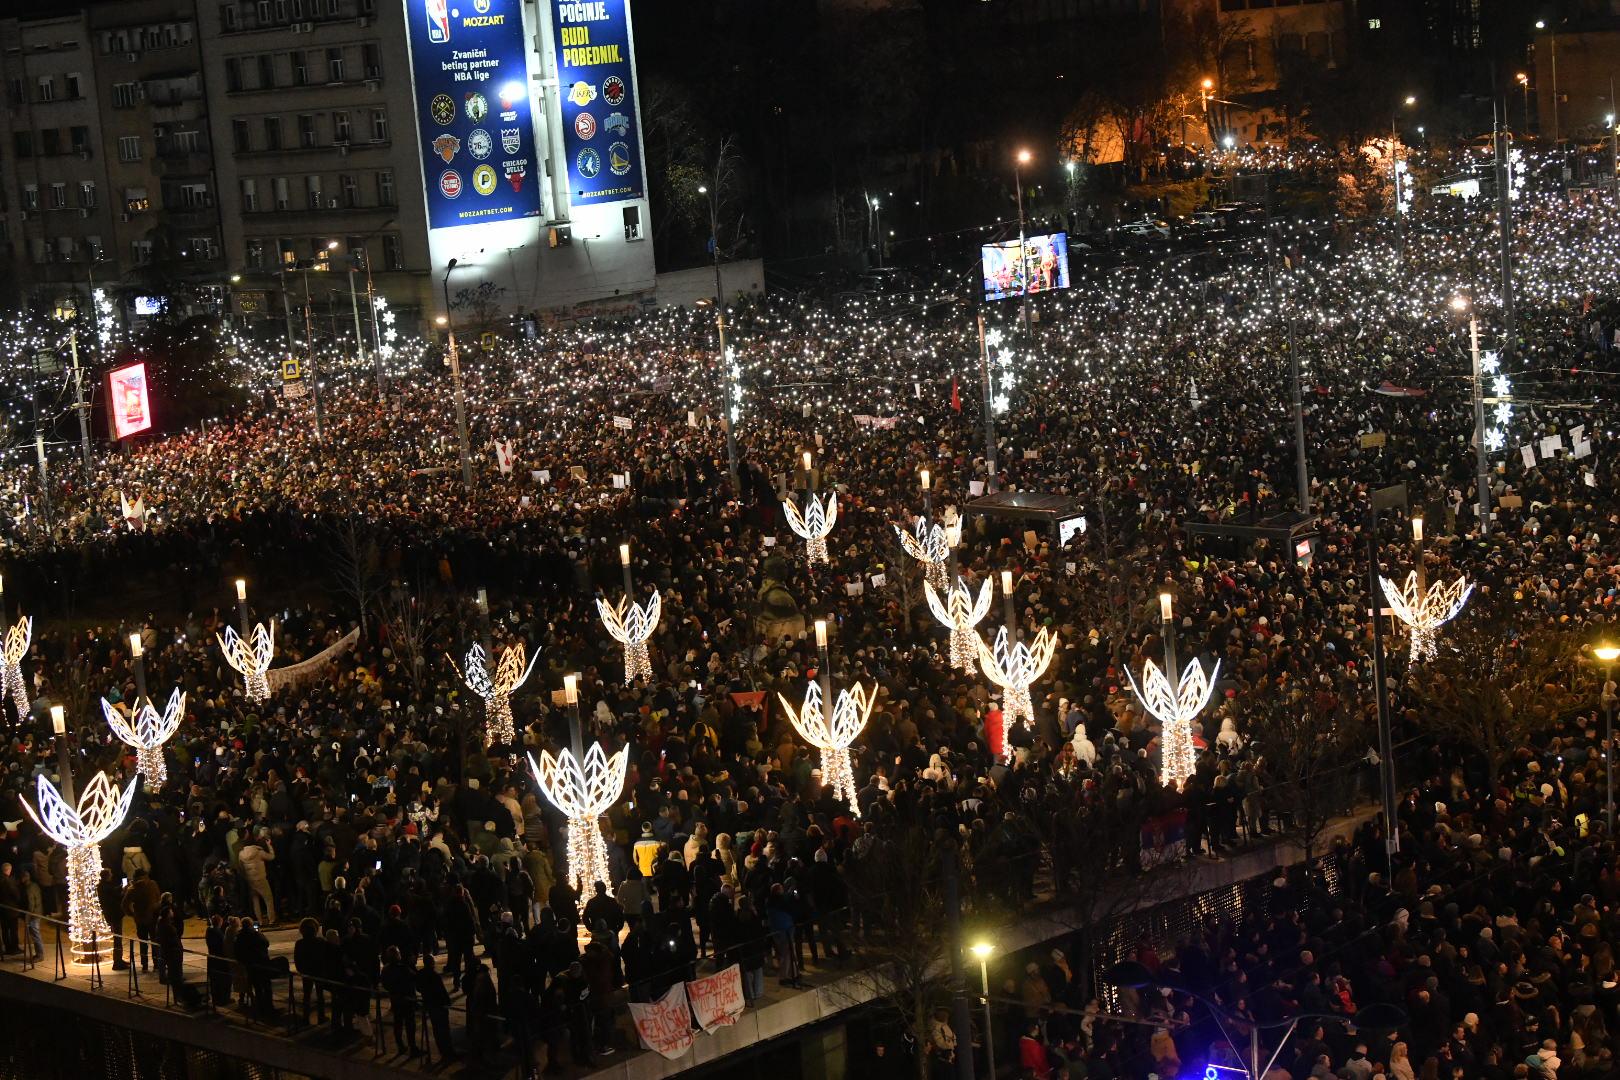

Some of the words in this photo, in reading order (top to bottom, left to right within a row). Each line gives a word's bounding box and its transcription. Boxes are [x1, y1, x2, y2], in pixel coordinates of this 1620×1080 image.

[558, 1, 610, 23] POČINJE.
[463, 15, 504, 27] MOZZART
[561, 26, 590, 47] BUDI
[452, 48, 487, 60] Zvanični
[563, 44, 623, 68] POBEDNIK.
[441, 60, 468, 71] beting
[469, 59, 500, 71] partner
[454, 71, 472, 82] NBA
[474, 70, 490, 81] lige
[502, 159, 528, 168] CHICAGO
[506, 165, 524, 173] BULLS
[581, 187, 632, 199] MOZZARTBET.COM
[459, 206, 513, 218] MOZZARTBET.COM
